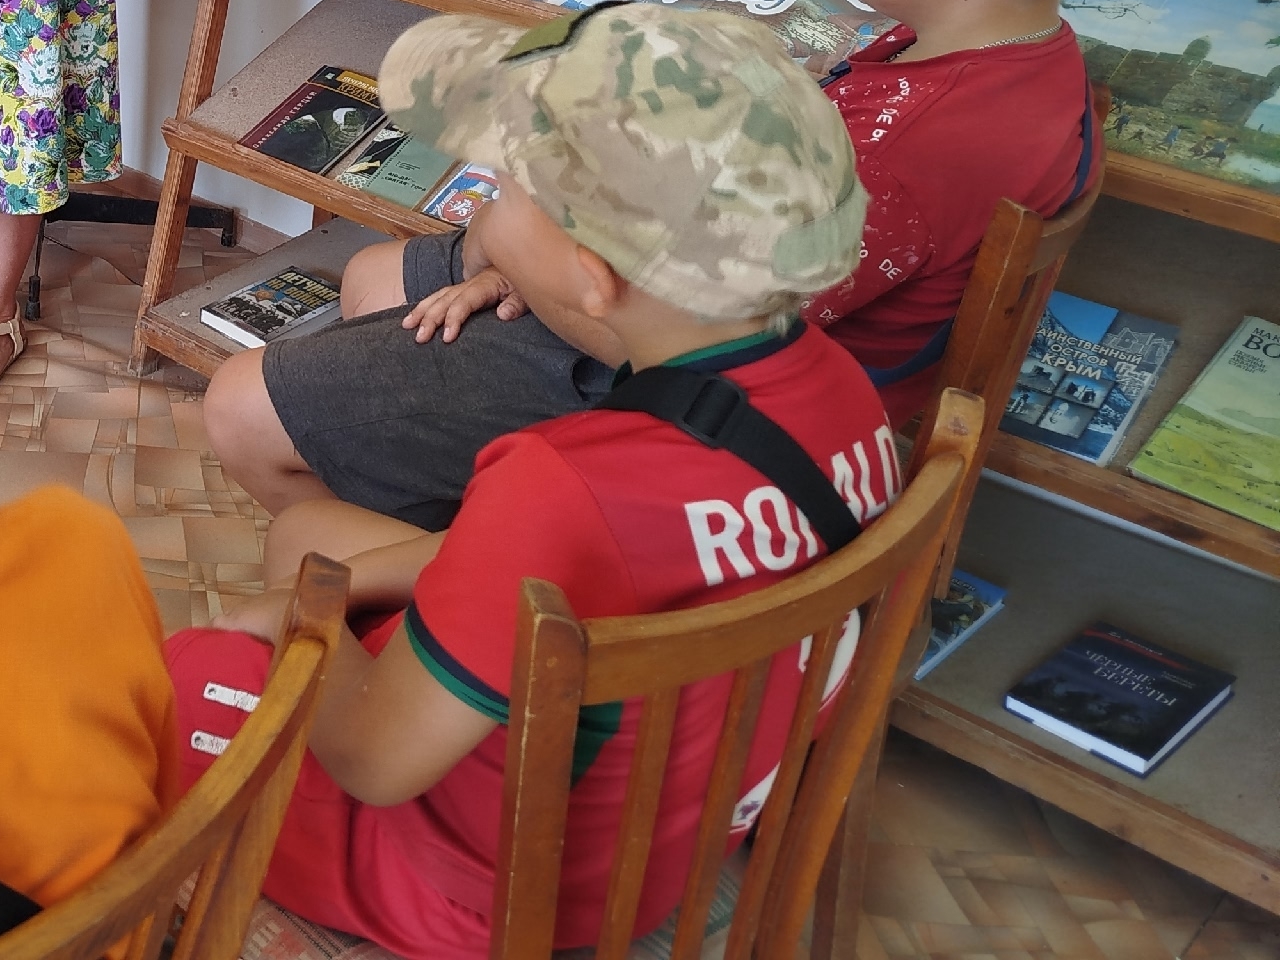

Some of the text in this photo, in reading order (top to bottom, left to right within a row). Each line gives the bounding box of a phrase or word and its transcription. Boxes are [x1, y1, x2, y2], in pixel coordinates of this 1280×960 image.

[878, 258, 903, 280] DE
[1041, 352, 1103, 381] КРЫМ
[1050, 343, 1109, 367] ОСТРОВ
[684, 425, 904, 587] ROALD
[1092, 666, 1178, 707] БЕРЕТЫ
